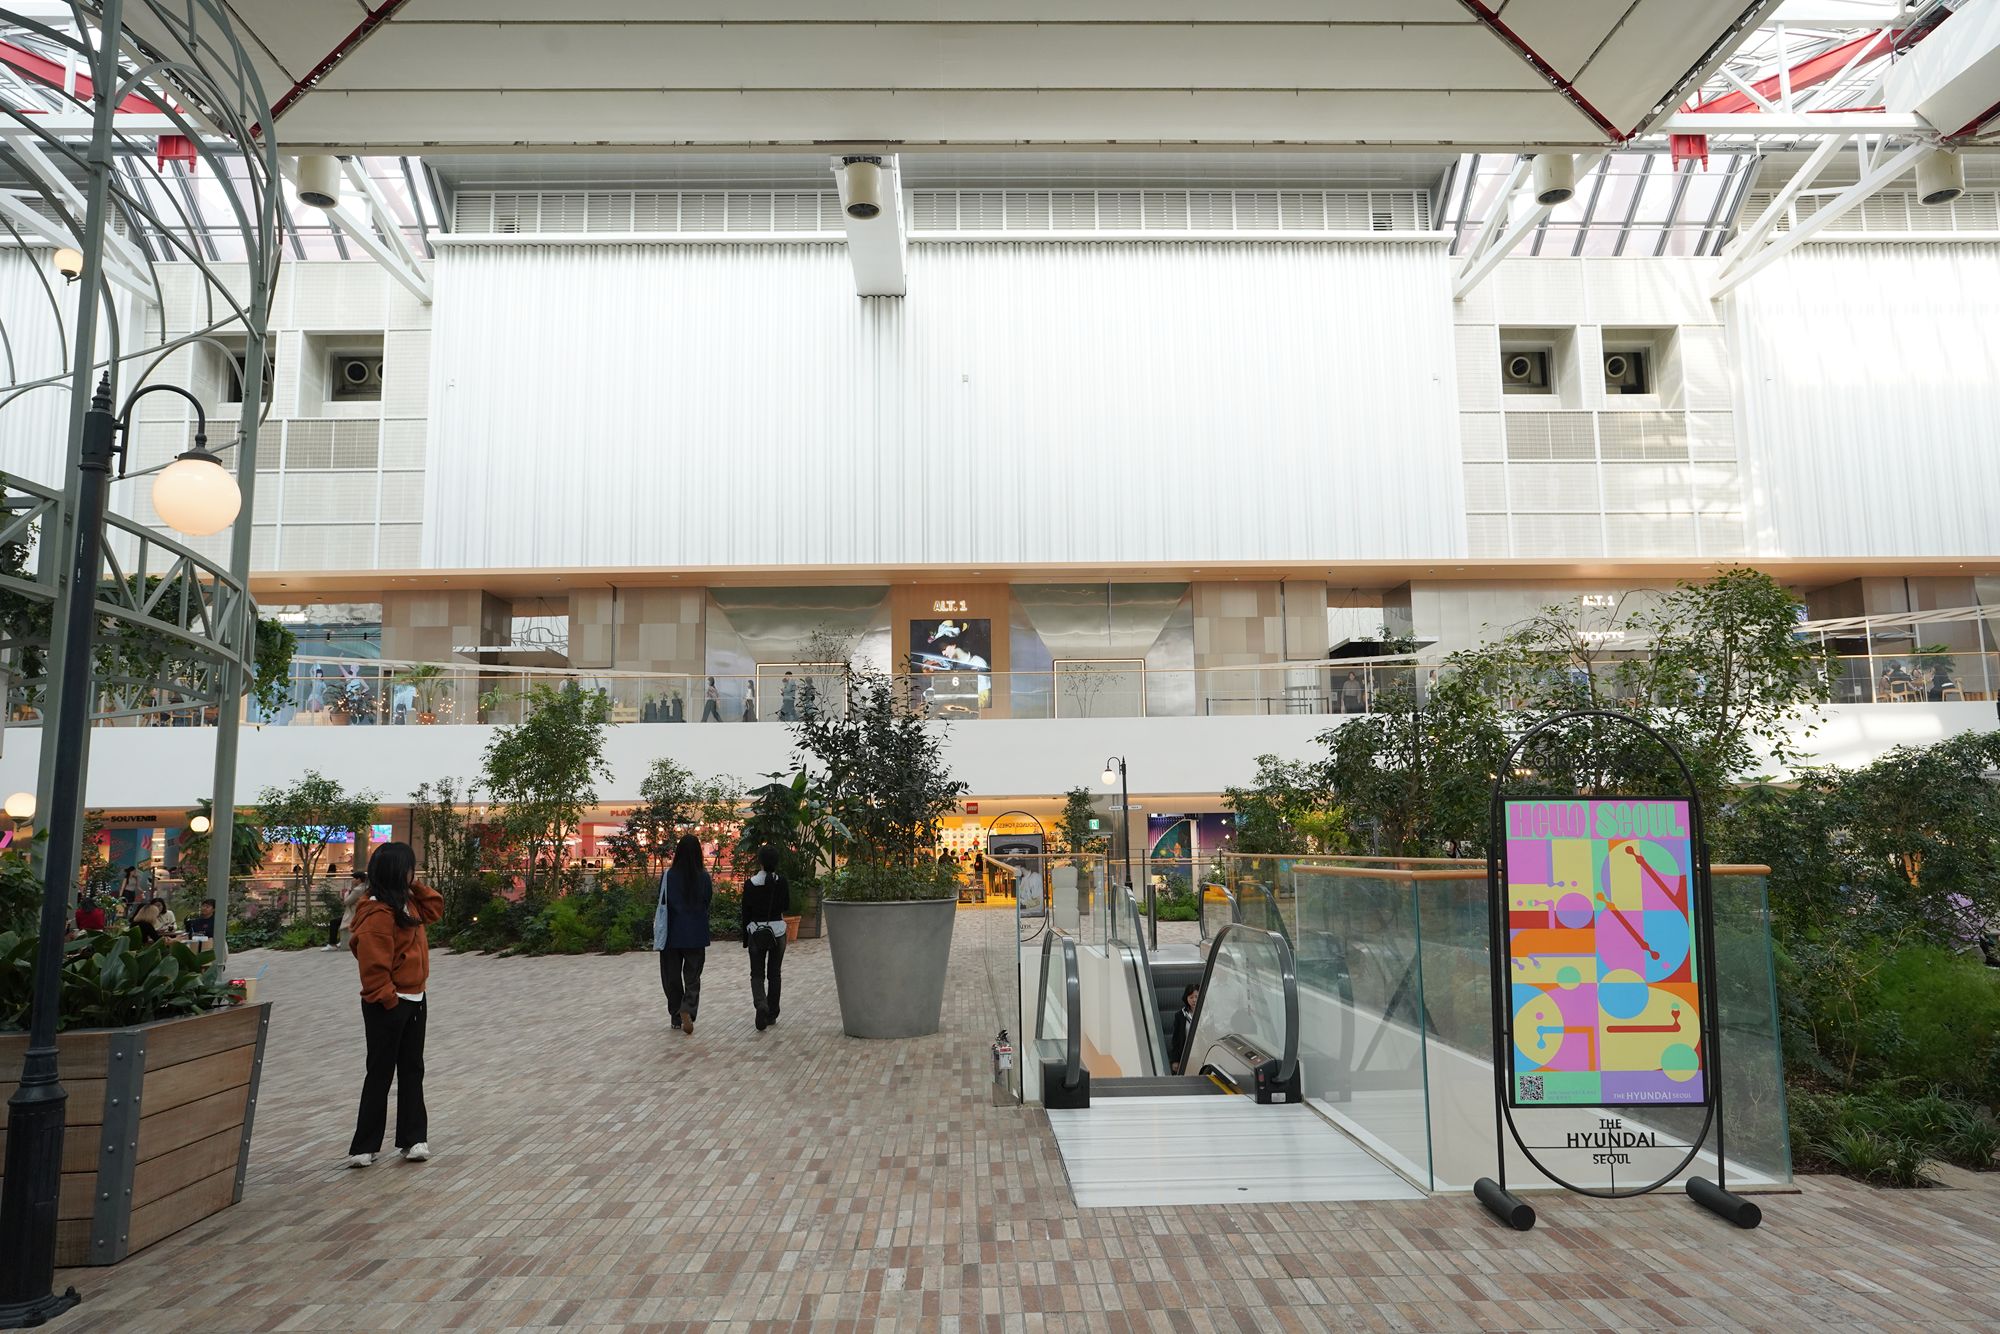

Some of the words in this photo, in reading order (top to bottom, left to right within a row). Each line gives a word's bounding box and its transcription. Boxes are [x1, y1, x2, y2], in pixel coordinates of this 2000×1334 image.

[933, 600, 958, 611] ALT.
[959, 600, 968, 611] 1
[1626, 1091, 1672, 1100] HYUNDAI
[1599, 1118, 1622, 1129] THE
[1567, 1132, 1656, 1148] HYUNDAI
[1593, 1153, 1631, 1164] SEOUL
